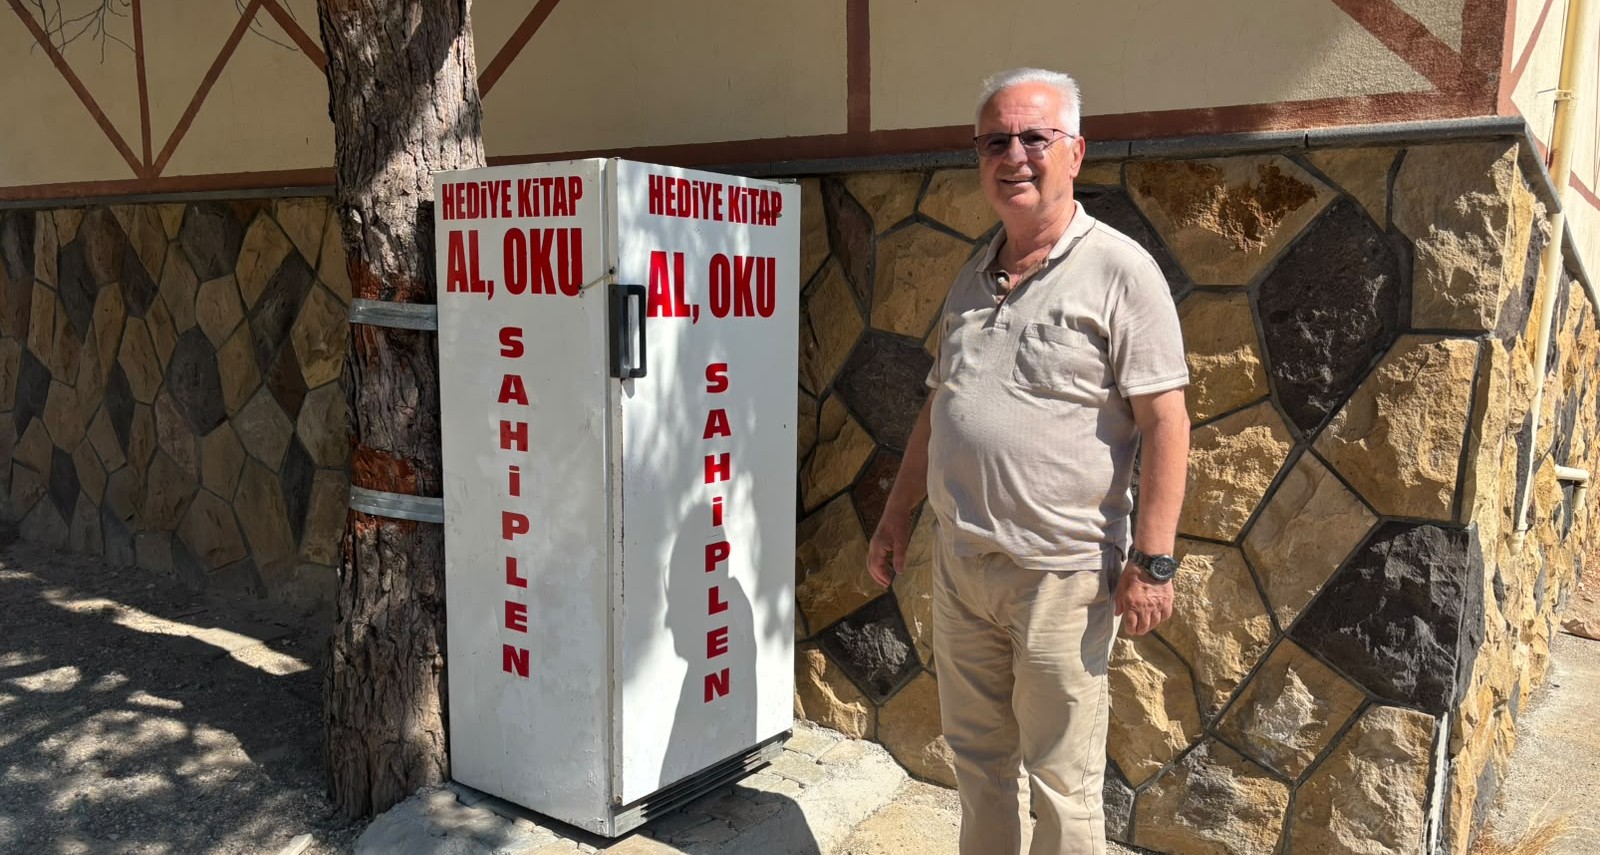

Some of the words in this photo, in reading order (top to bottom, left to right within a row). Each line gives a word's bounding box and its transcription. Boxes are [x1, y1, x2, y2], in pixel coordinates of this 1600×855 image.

[446, 229, 495, 300] AL,
[503, 227, 584, 297] OKU
[646, 250, 700, 325] AL,
[709, 253, 777, 320] OKU
